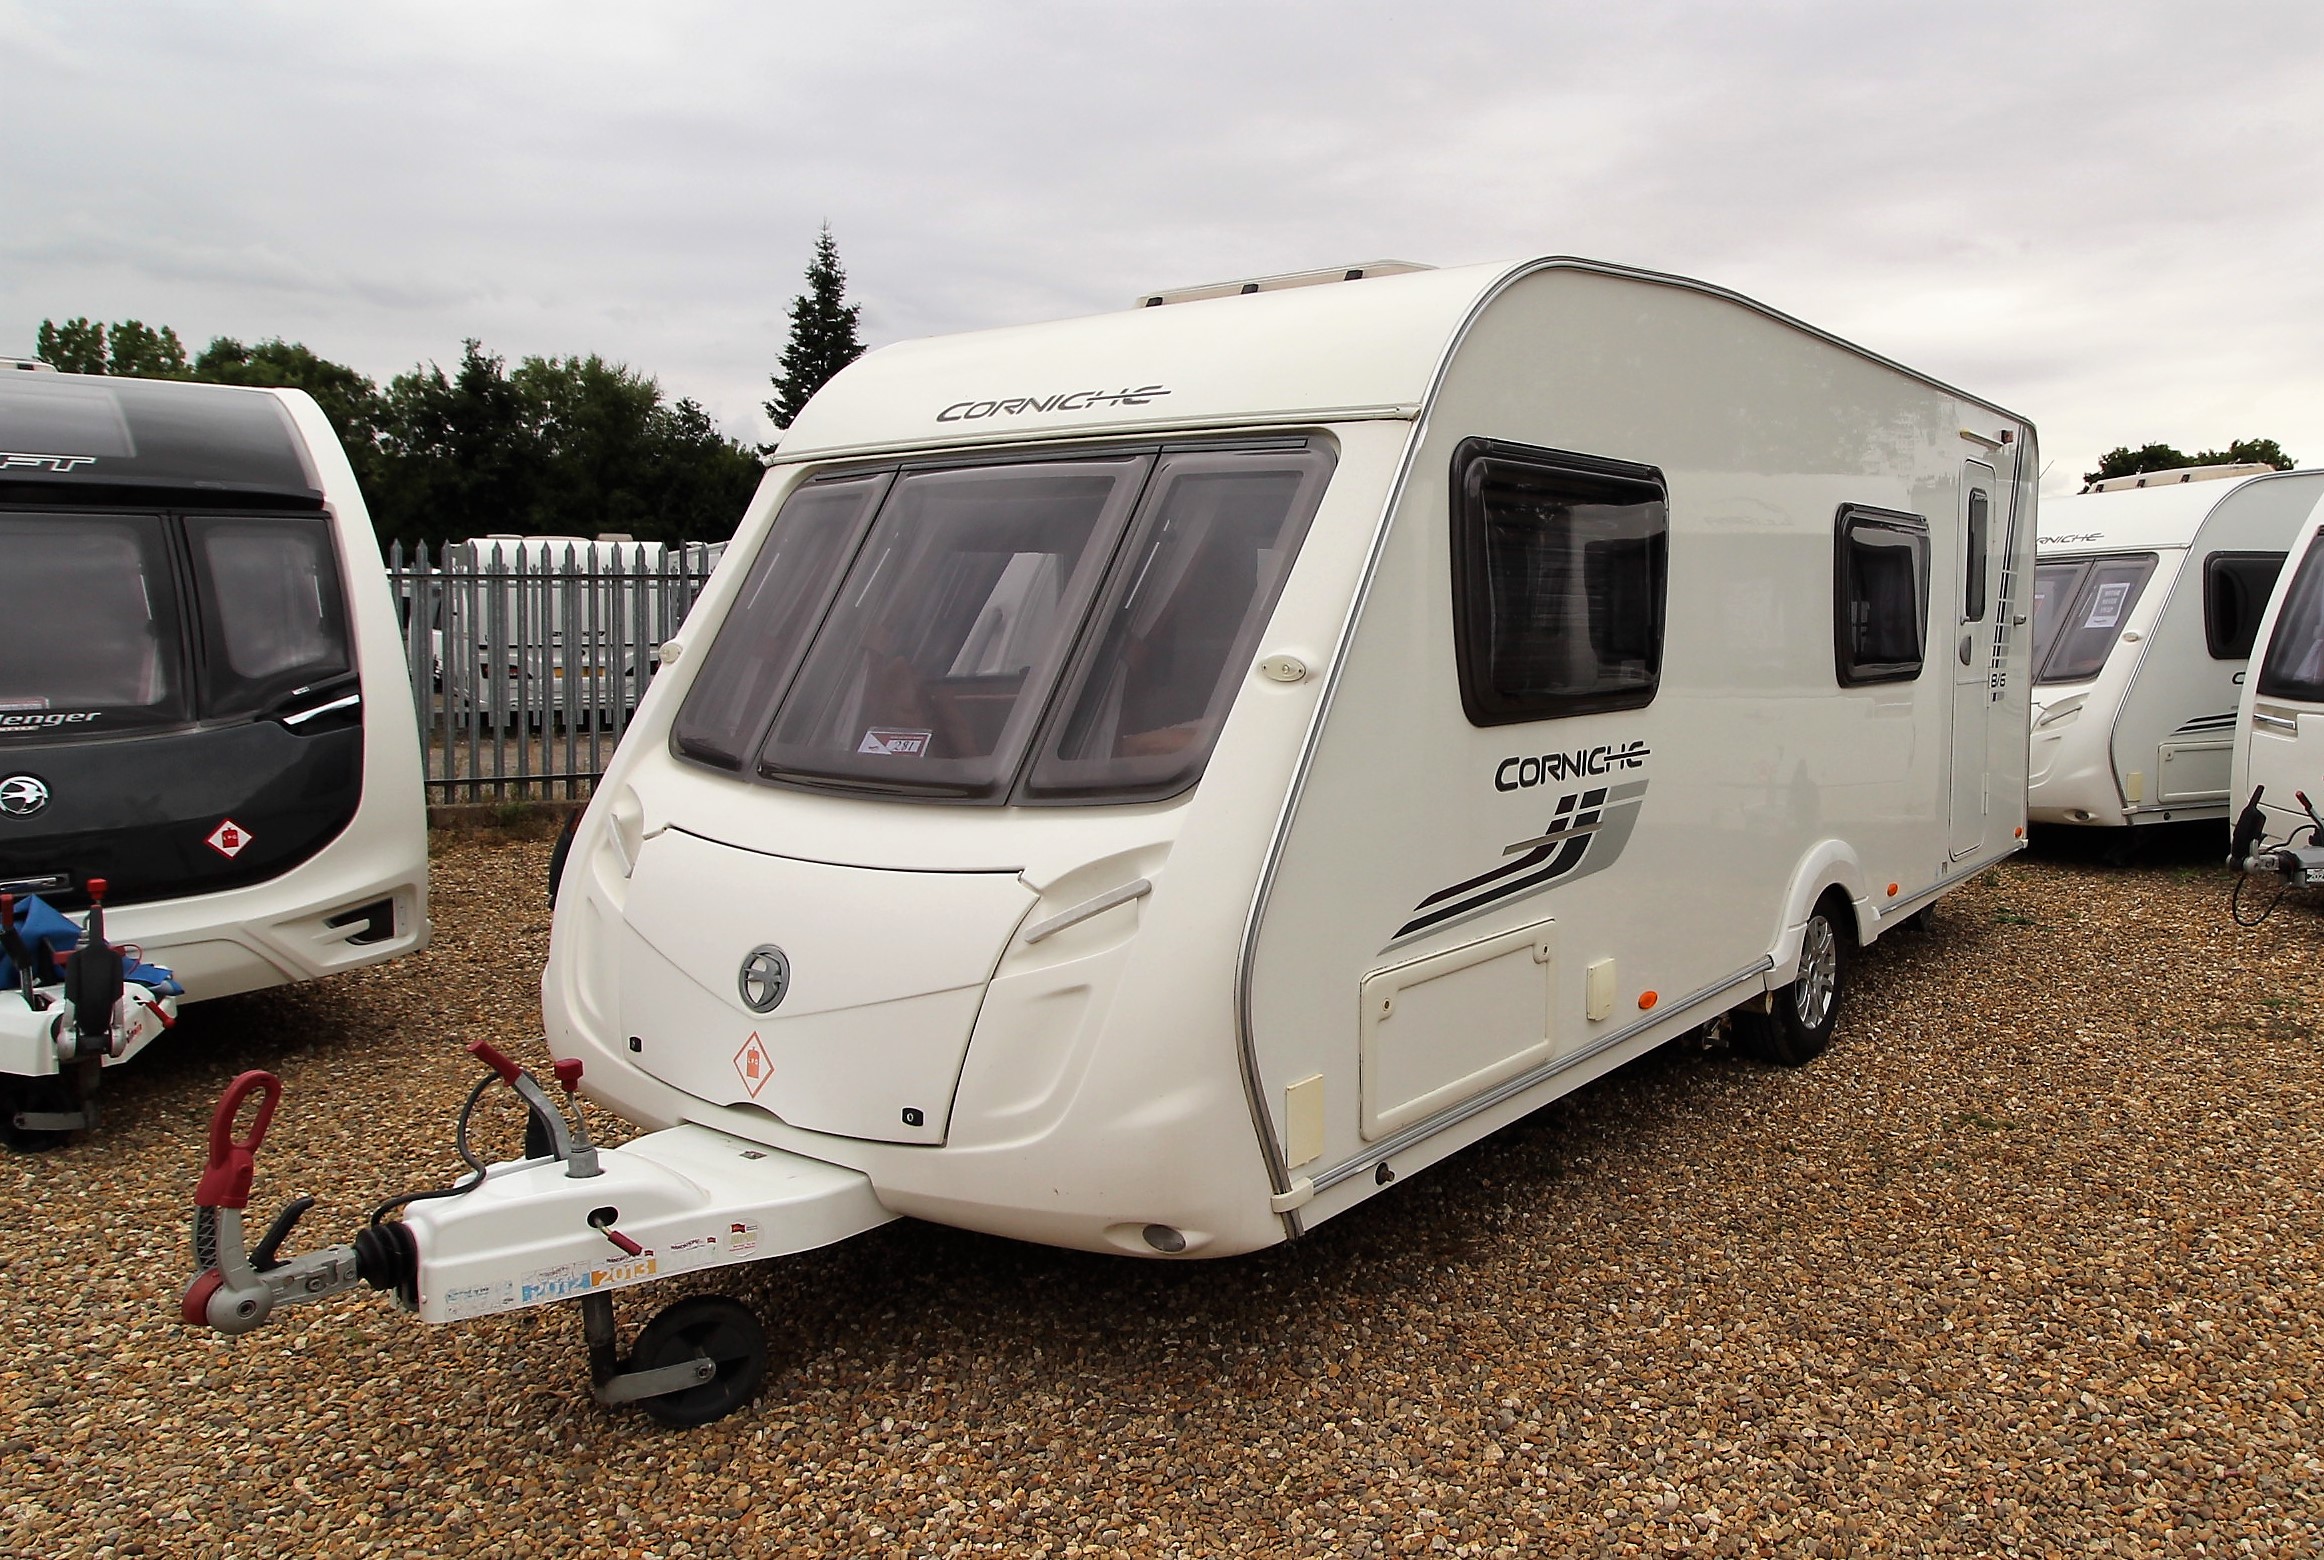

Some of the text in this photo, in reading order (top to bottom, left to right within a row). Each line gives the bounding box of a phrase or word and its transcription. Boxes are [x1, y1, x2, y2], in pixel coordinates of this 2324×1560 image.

[936, 385, 1172, 422] CORNICHE
[1494, 741, 1651, 792] CORNICHE
[598, 1262, 651, 1286] 2013
